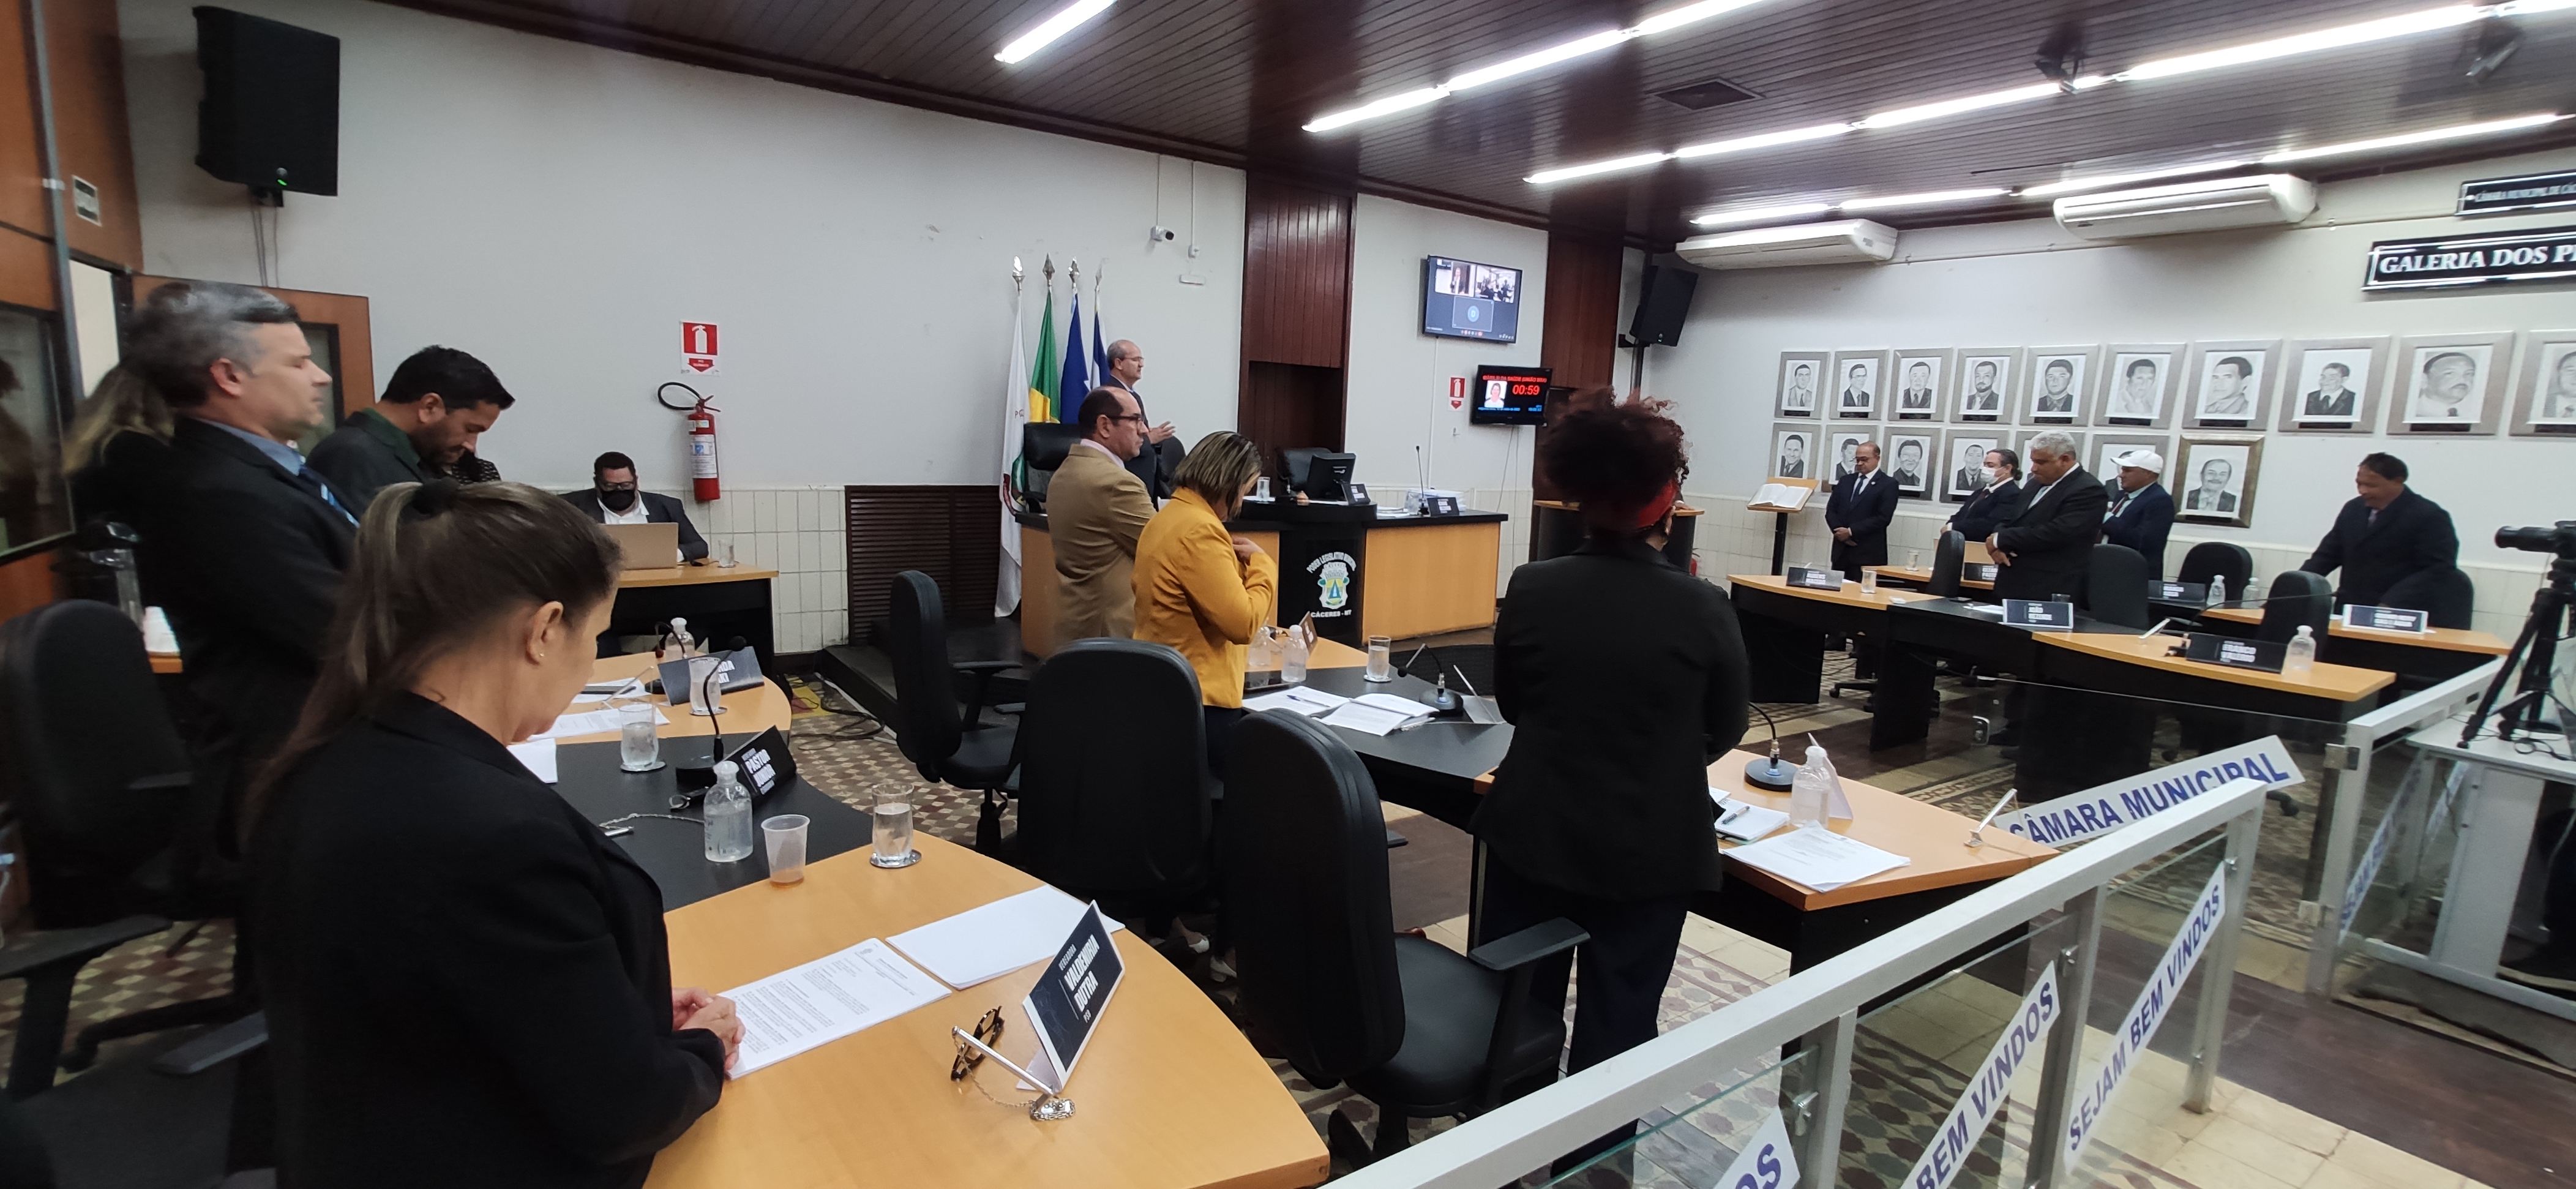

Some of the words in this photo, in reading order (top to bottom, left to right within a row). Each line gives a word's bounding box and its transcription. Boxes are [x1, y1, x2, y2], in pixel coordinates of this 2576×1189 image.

[2379, 251, 2486, 273] GALERIA
[2490, 246, 2548, 266] DOS
[1512, 384, 1540, 395] 00:59
[745, 749, 771, 774] PASTOR
[2119, 753, 2290, 820] MUNICIPAL
[1074, 970, 1099, 1012] DUTRA
[1083, 1009, 1091, 1024] PSB
[2070, 1041, 2127, 1150] SEJAM
[2130, 978, 2164, 1053] BEM
[2167, 884, 2220, 988] VINDOS
[1916, 1110, 1969, 1189] BEM
[1971, 982, 2053, 1120] VINDOS
